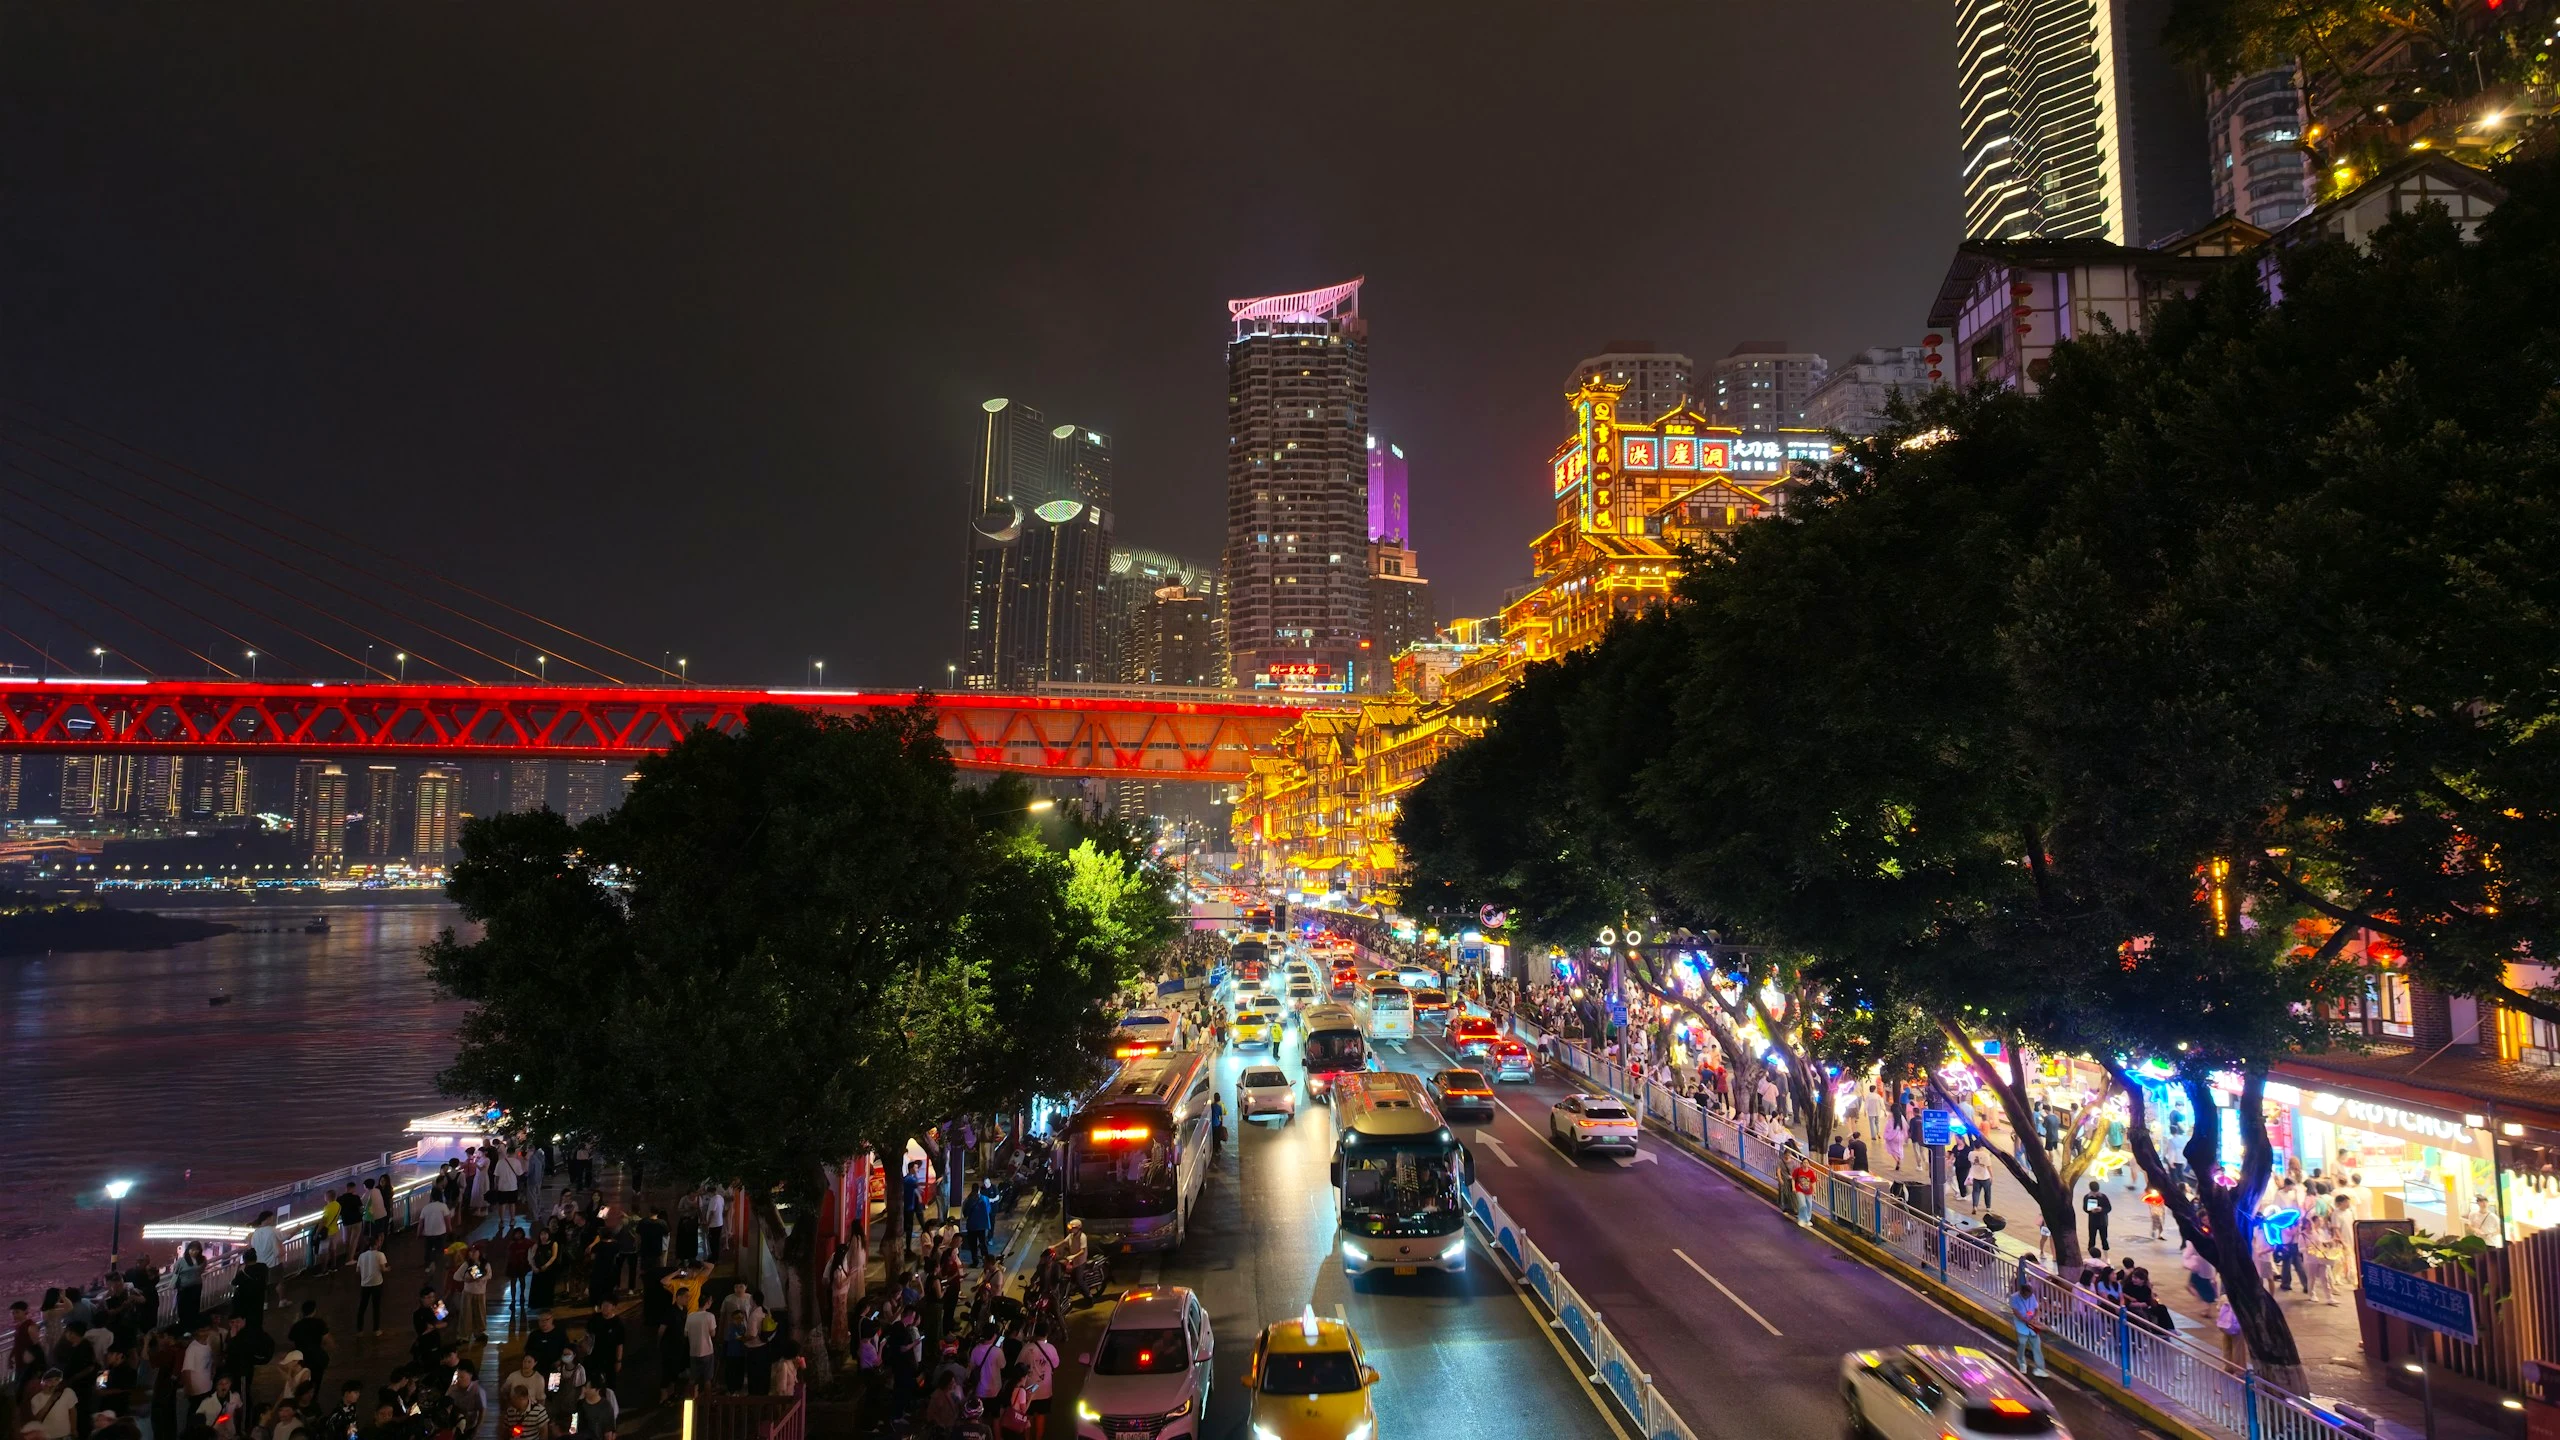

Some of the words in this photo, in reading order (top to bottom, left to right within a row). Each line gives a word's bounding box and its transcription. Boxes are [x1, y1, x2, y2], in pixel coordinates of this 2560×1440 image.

[1629, 443, 1724, 467] 洪崖洞
[2367, 1265, 2465, 1317] 嘉陵江滨江路
